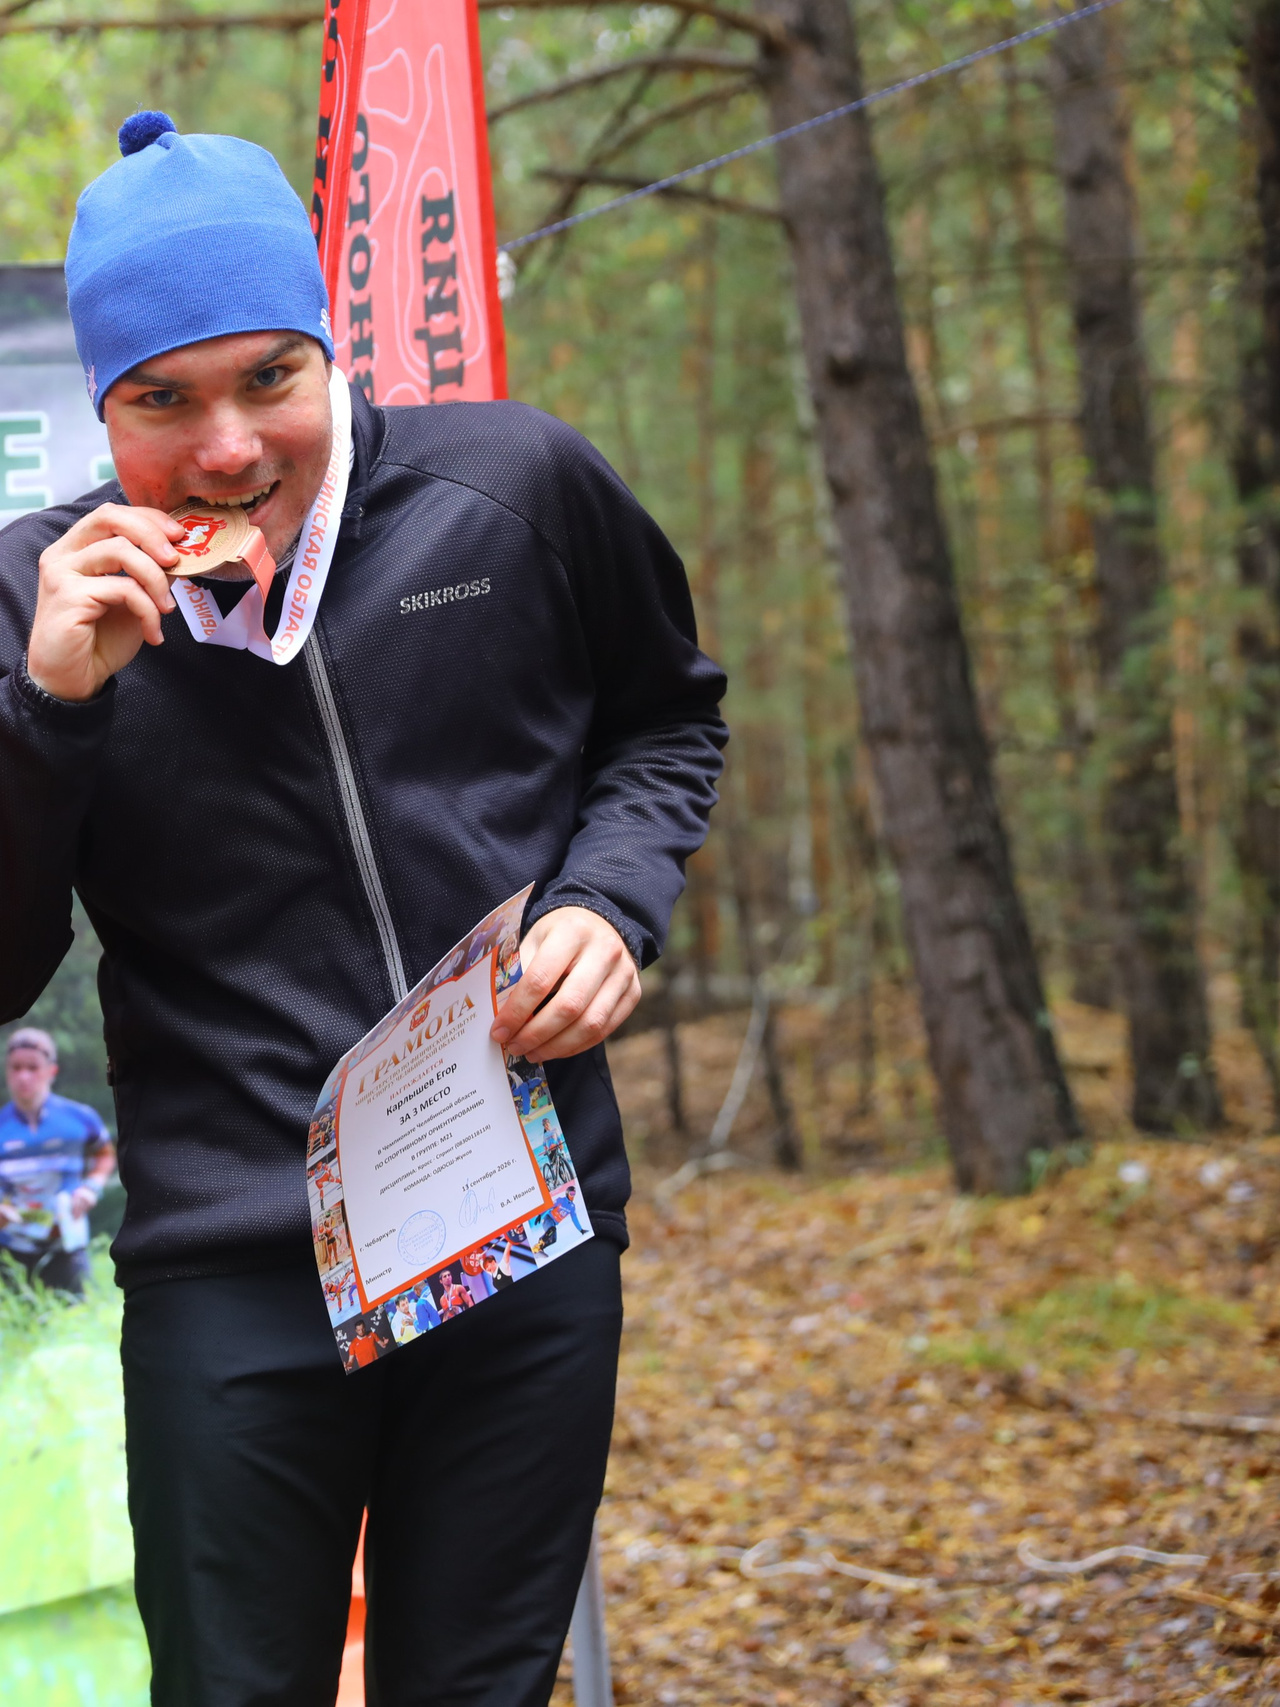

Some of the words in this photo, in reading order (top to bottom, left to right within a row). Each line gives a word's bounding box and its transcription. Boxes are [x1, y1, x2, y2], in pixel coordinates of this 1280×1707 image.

[302, 424, 342, 571] ЧЕЛЯБИНСКАЯ
[400, 577, 491, 614] SKIKROSS
[356, 993, 475, 1097] ГРАМОТА
[386, 1078, 434, 1116] Карлышев
[436, 1063, 457, 1081] Егор
[390, 1058, 443, 1101] НАГРАЖДАЕТСЯ
[400, 1113, 411, 1125] ЗА
[413, 1107, 418, 1116] 3
[419, 1086, 451, 1112] МЕСТО
[416, 1102, 453, 1128] Челябинской
[374, 1161, 384, 1171] ПО
[384, 1132, 427, 1164] СПОРТИВНОМУ
[428, 1098, 484, 1136] ОРИЕНТИРОВАНИЮ
[440, 1132, 453, 1143] М21
[470, 1169, 496, 1187] сентября
[513, 1186, 535, 1201] Иванов
[365, 1228, 396, 1248] Чебаркуль
[365, 1267, 392, 1285] Министр
